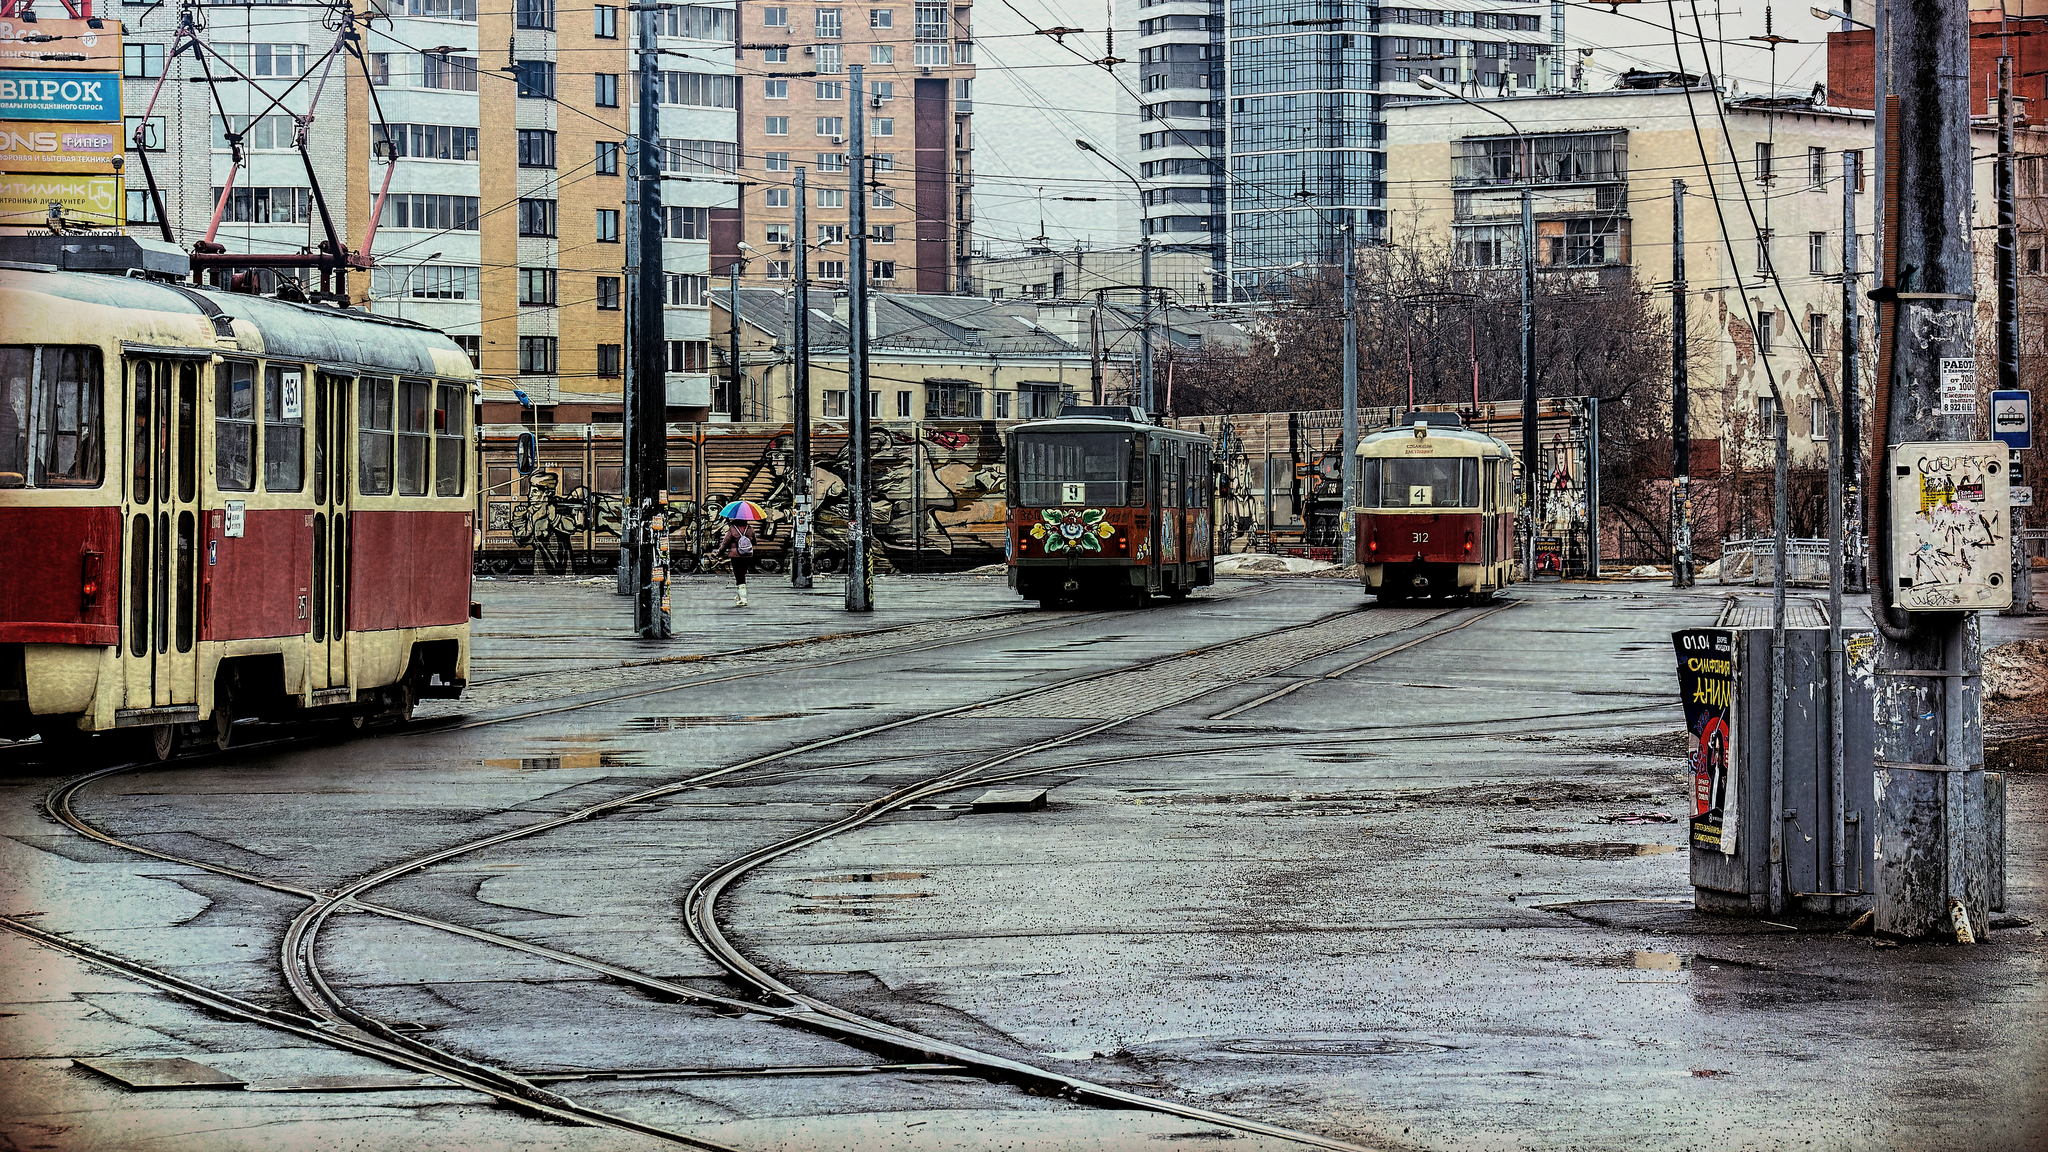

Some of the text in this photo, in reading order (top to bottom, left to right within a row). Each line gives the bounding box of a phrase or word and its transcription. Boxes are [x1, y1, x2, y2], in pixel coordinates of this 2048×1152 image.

[0, 80, 102, 101] ВПРОК
[285, 379, 297, 406] 351
[1069, 484, 1078, 500] 9
[1414, 488, 1425, 502] 4
[1412, 532, 1429, 543] 312
[298, 595, 307, 619] 351
